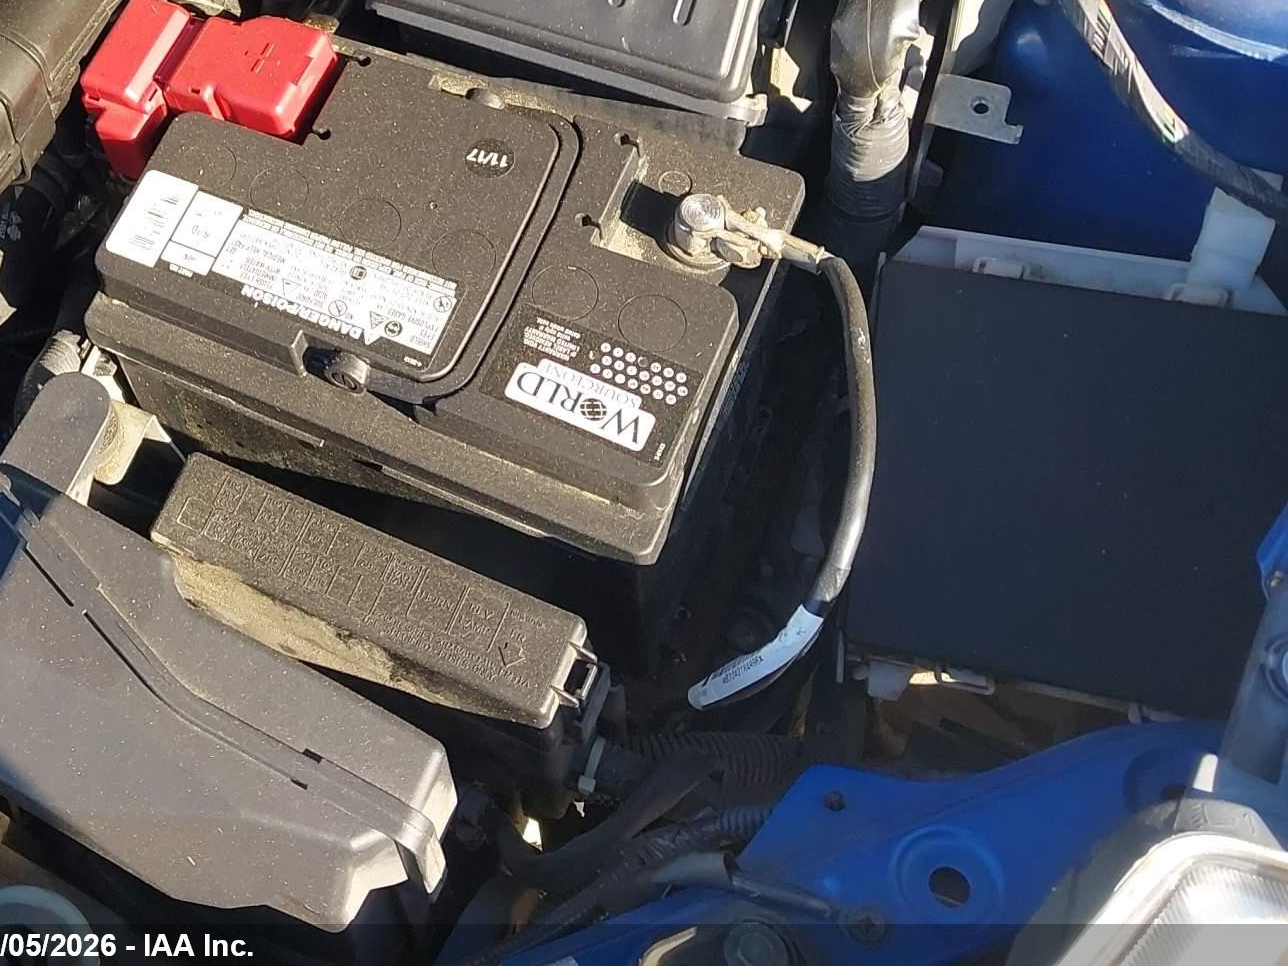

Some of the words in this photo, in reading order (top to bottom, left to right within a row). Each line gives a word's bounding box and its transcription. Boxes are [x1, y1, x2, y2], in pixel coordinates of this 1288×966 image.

[465, 147, 509, 169] 11/17
[241, 284, 362, 339] DANGER/POISON
[517, 371, 639, 444] WORLD
